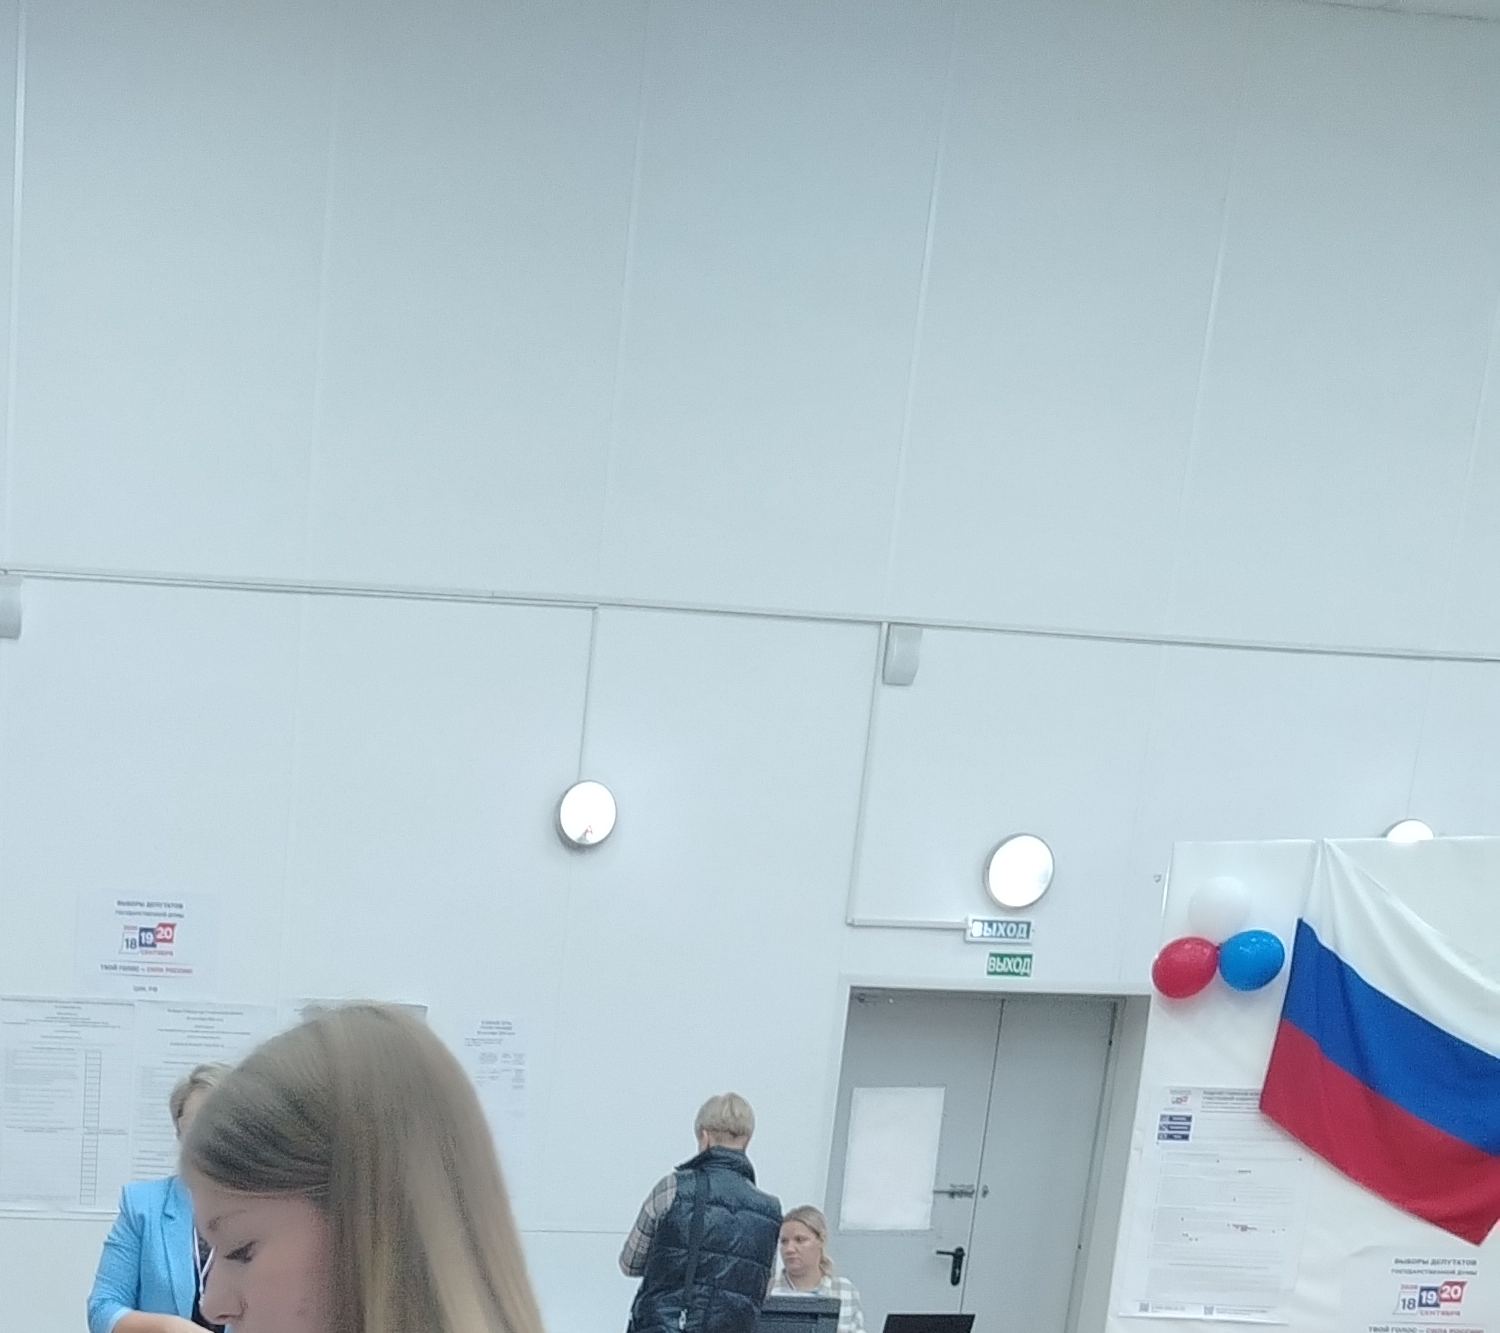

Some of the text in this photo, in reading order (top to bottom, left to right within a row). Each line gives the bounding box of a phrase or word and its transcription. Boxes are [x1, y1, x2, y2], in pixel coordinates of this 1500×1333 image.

[125, 927, 173, 949] 18 19 20
[987, 956, 1032, 976] ВЫХОД
[1394, 1258, 1478, 1267] ВЫБОРЫ ДЕПУТАТОВ
[1401, 1285, 1462, 1310] 18 19 20
